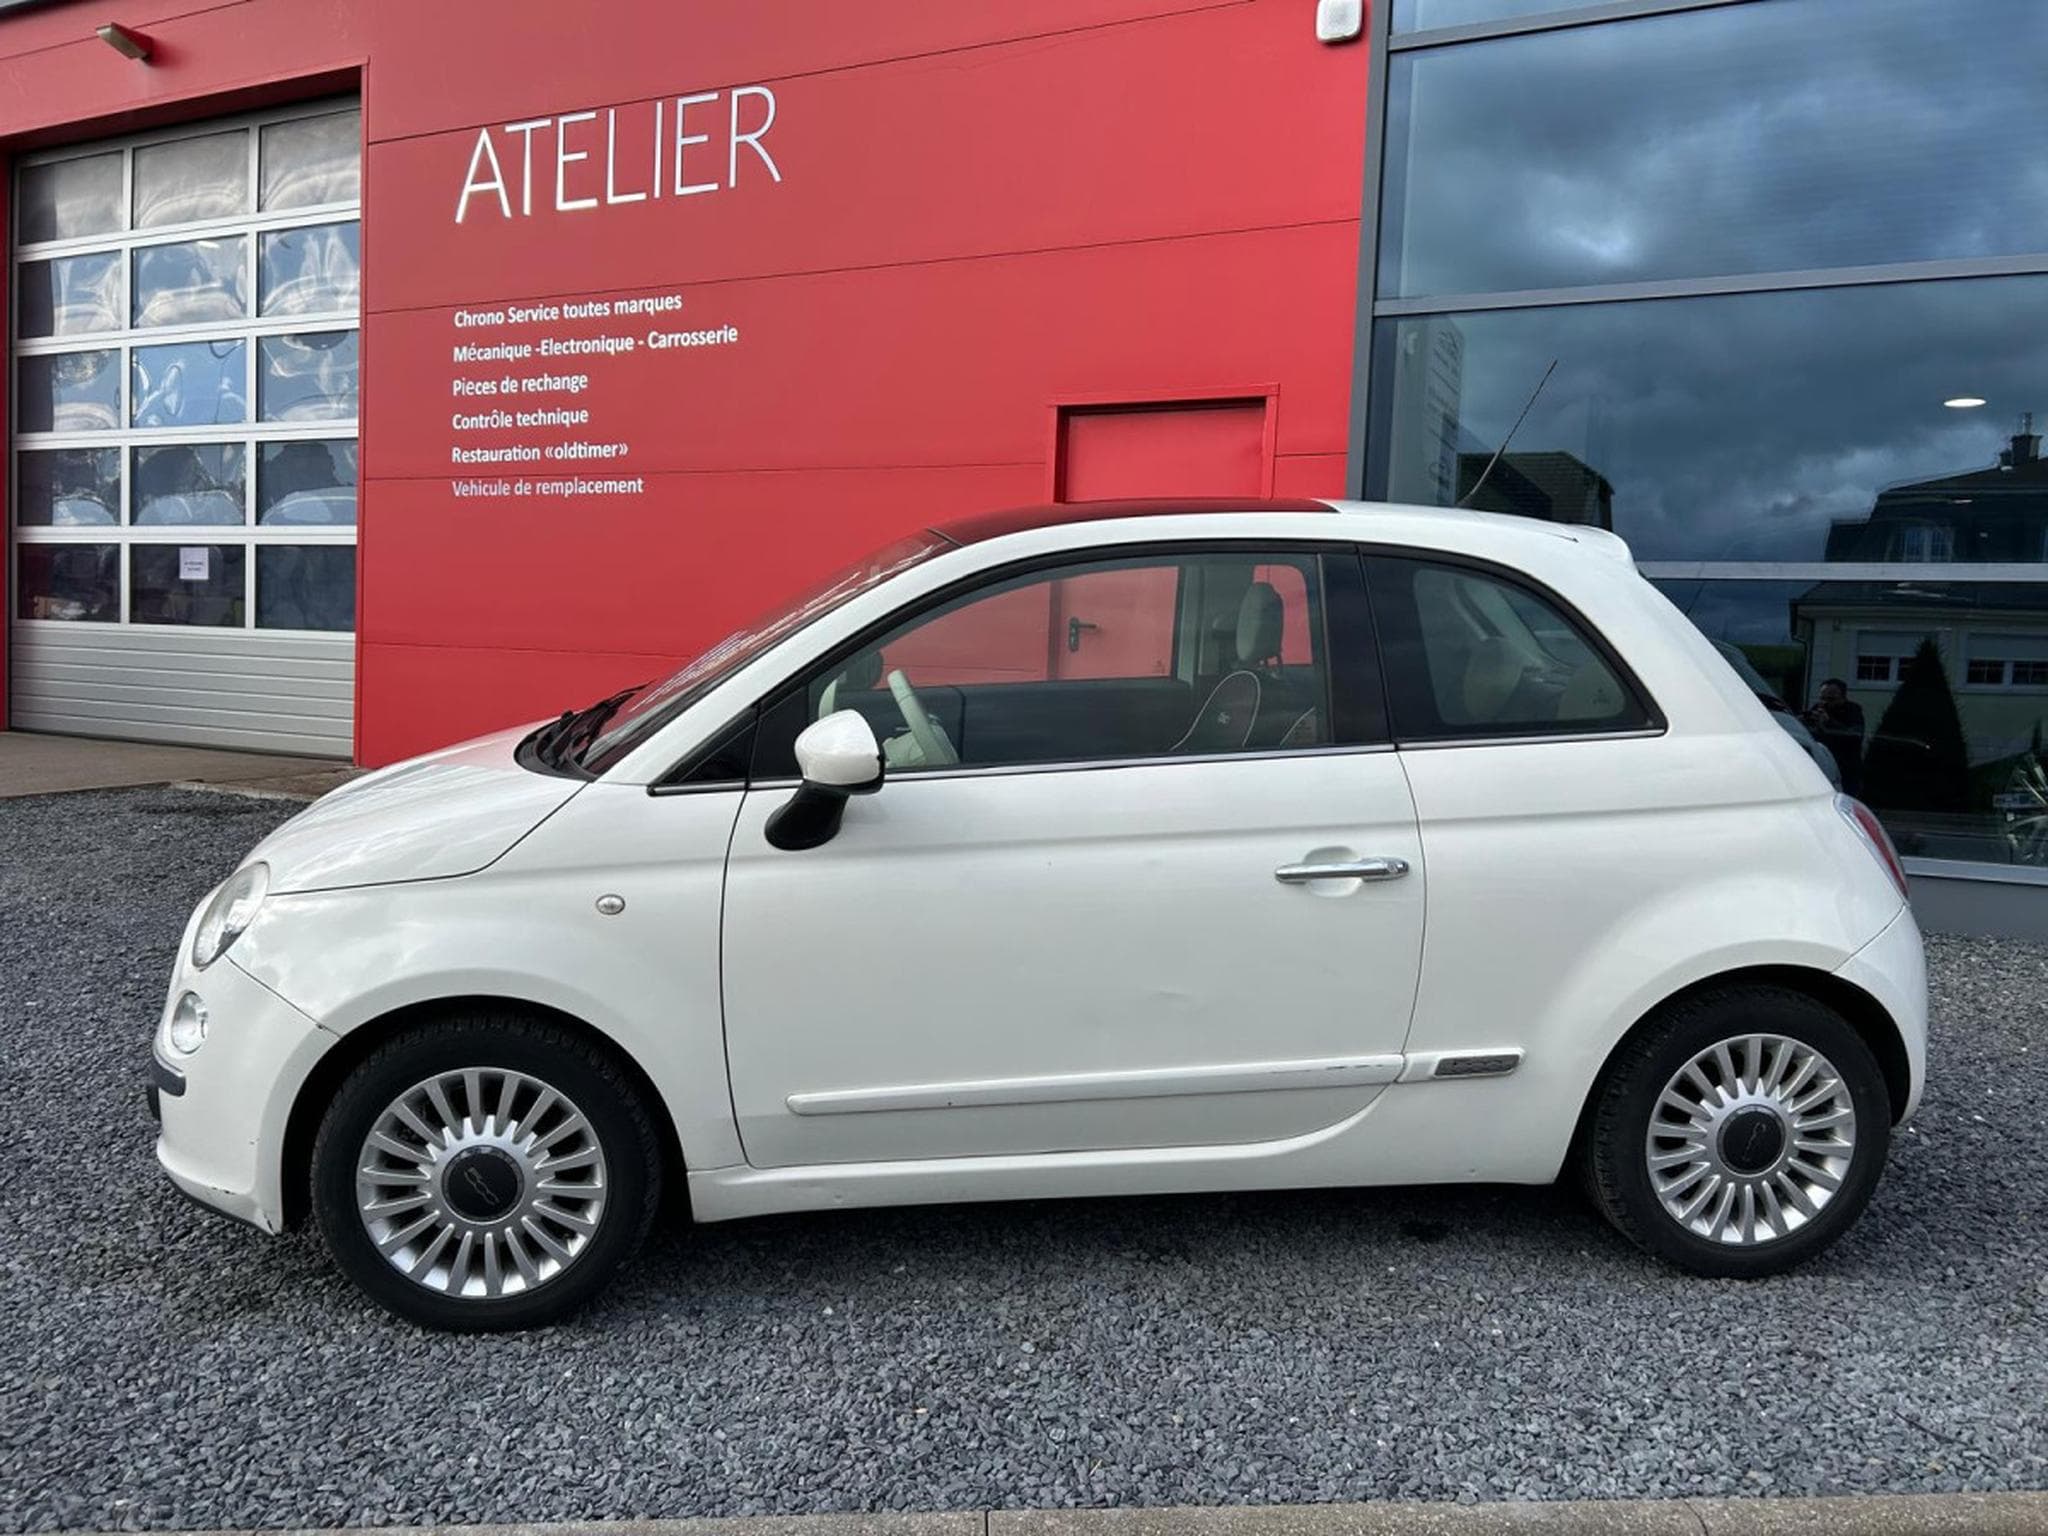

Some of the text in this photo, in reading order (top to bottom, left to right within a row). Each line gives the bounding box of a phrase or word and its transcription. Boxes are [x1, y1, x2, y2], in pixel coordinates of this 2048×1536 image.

[455, 85, 781, 224] ATELIER
[454, 295, 683, 328] Chrono Service toutes marques
[454, 342, 533, 363] Mécanique
[647, 325, 739, 349] Carrosserie
[453, 373, 589, 397] Pieces de rechange
[516, 408, 590, 428] technique
[452, 444, 541, 464] Restauration
[452, 477, 644, 498] Vehicule de remplacement
